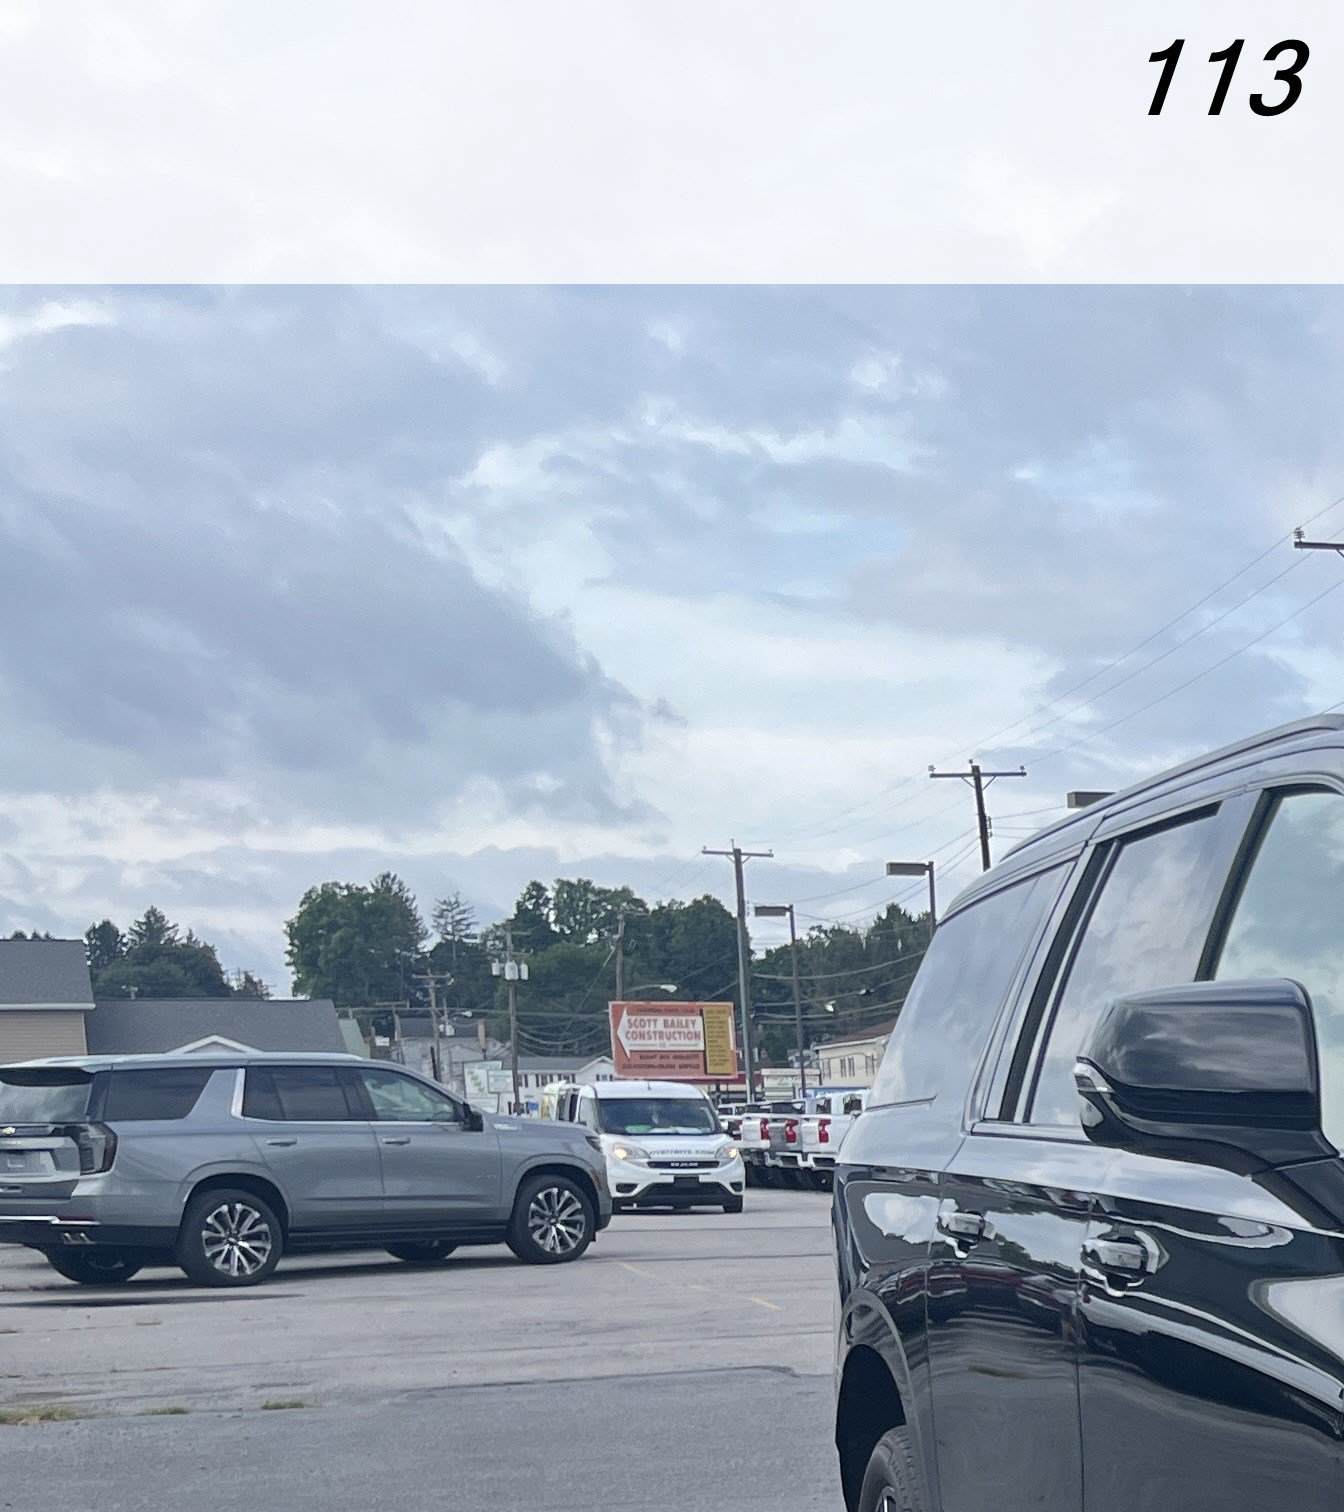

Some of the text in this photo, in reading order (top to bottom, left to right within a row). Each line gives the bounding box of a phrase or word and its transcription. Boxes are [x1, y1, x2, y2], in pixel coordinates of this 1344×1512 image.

[627, 1018, 697, 1029] SCOTT BAILEY
[625, 1030, 702, 1041] CONSTRUCTION
